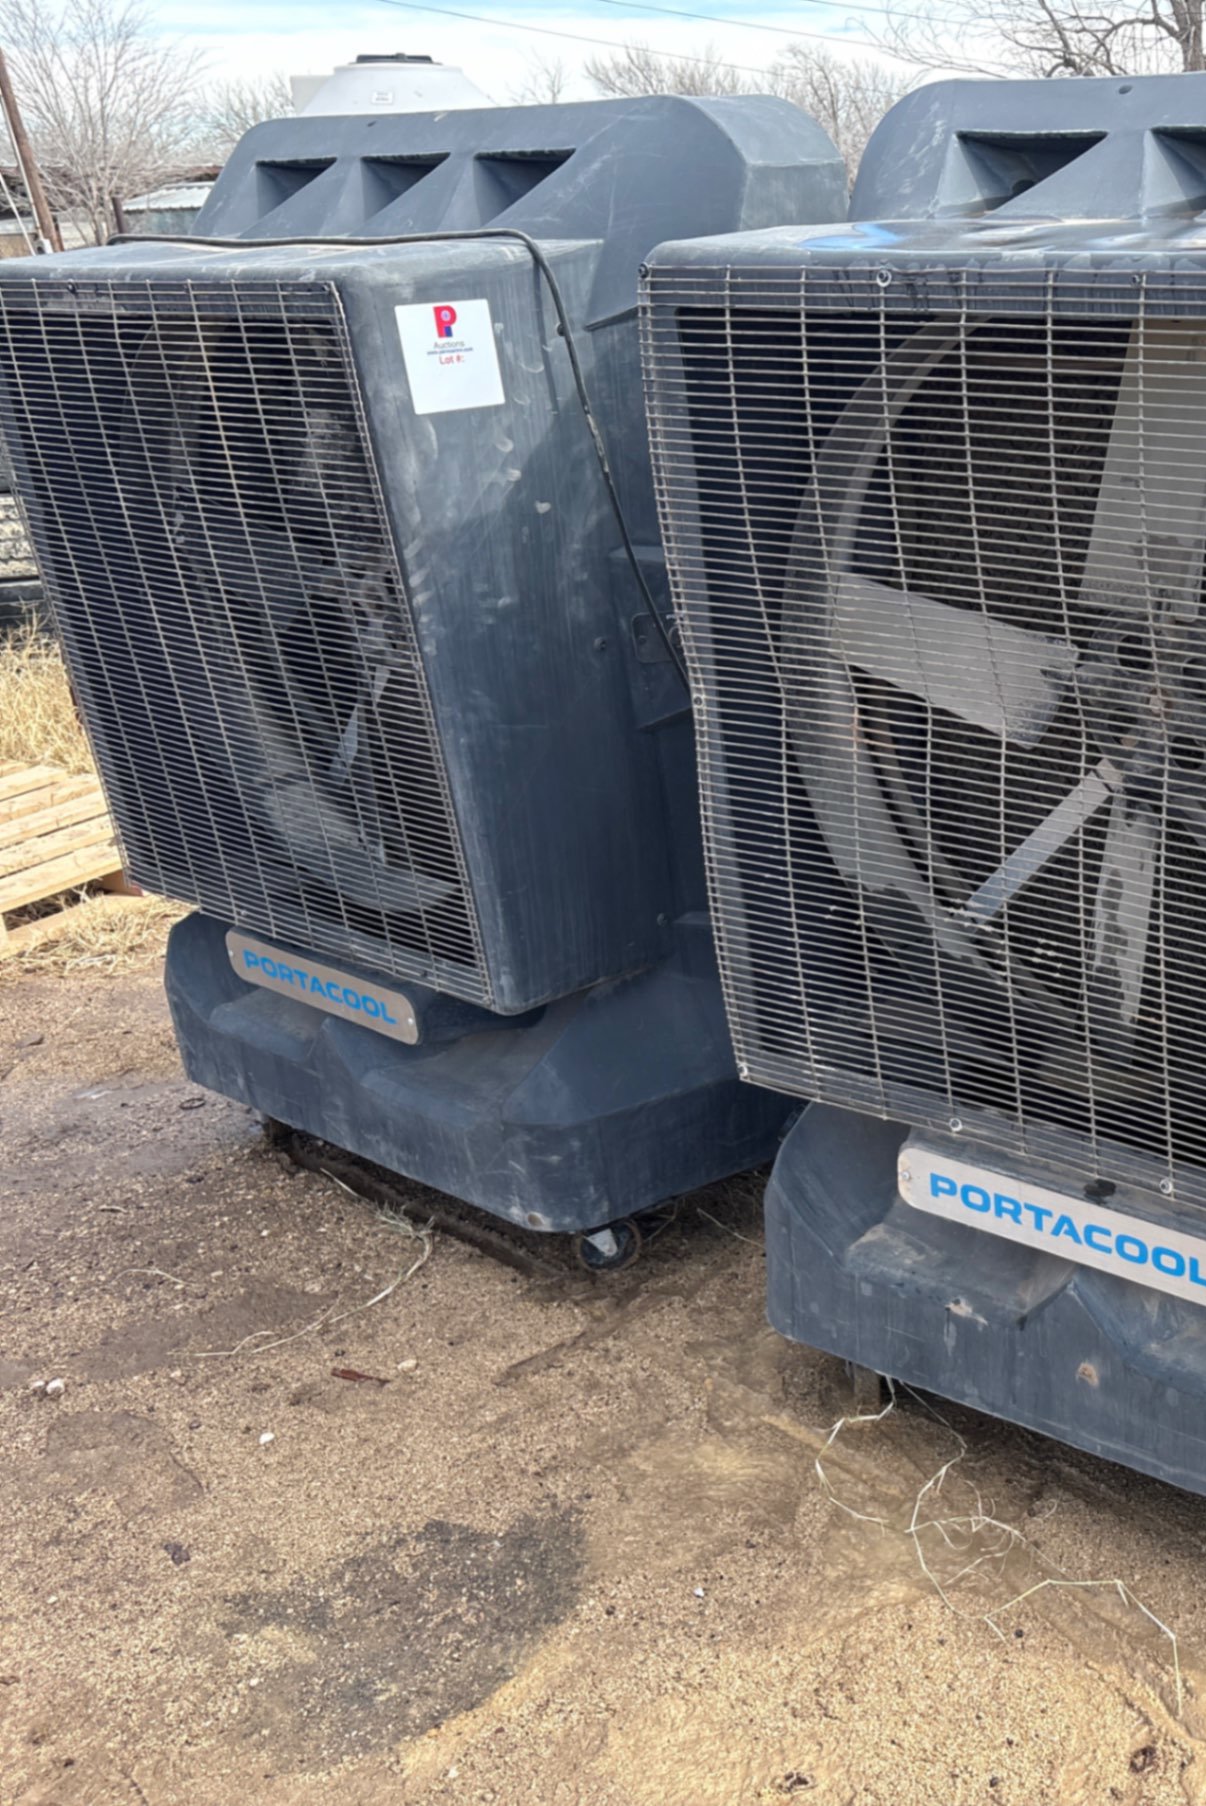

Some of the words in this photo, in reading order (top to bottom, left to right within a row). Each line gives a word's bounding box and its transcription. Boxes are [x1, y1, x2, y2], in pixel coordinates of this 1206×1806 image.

[433, 340, 465, 350] Auctions
[439, 354, 454, 365] Lot
[242, 949, 397, 1025] PORTACOOL
